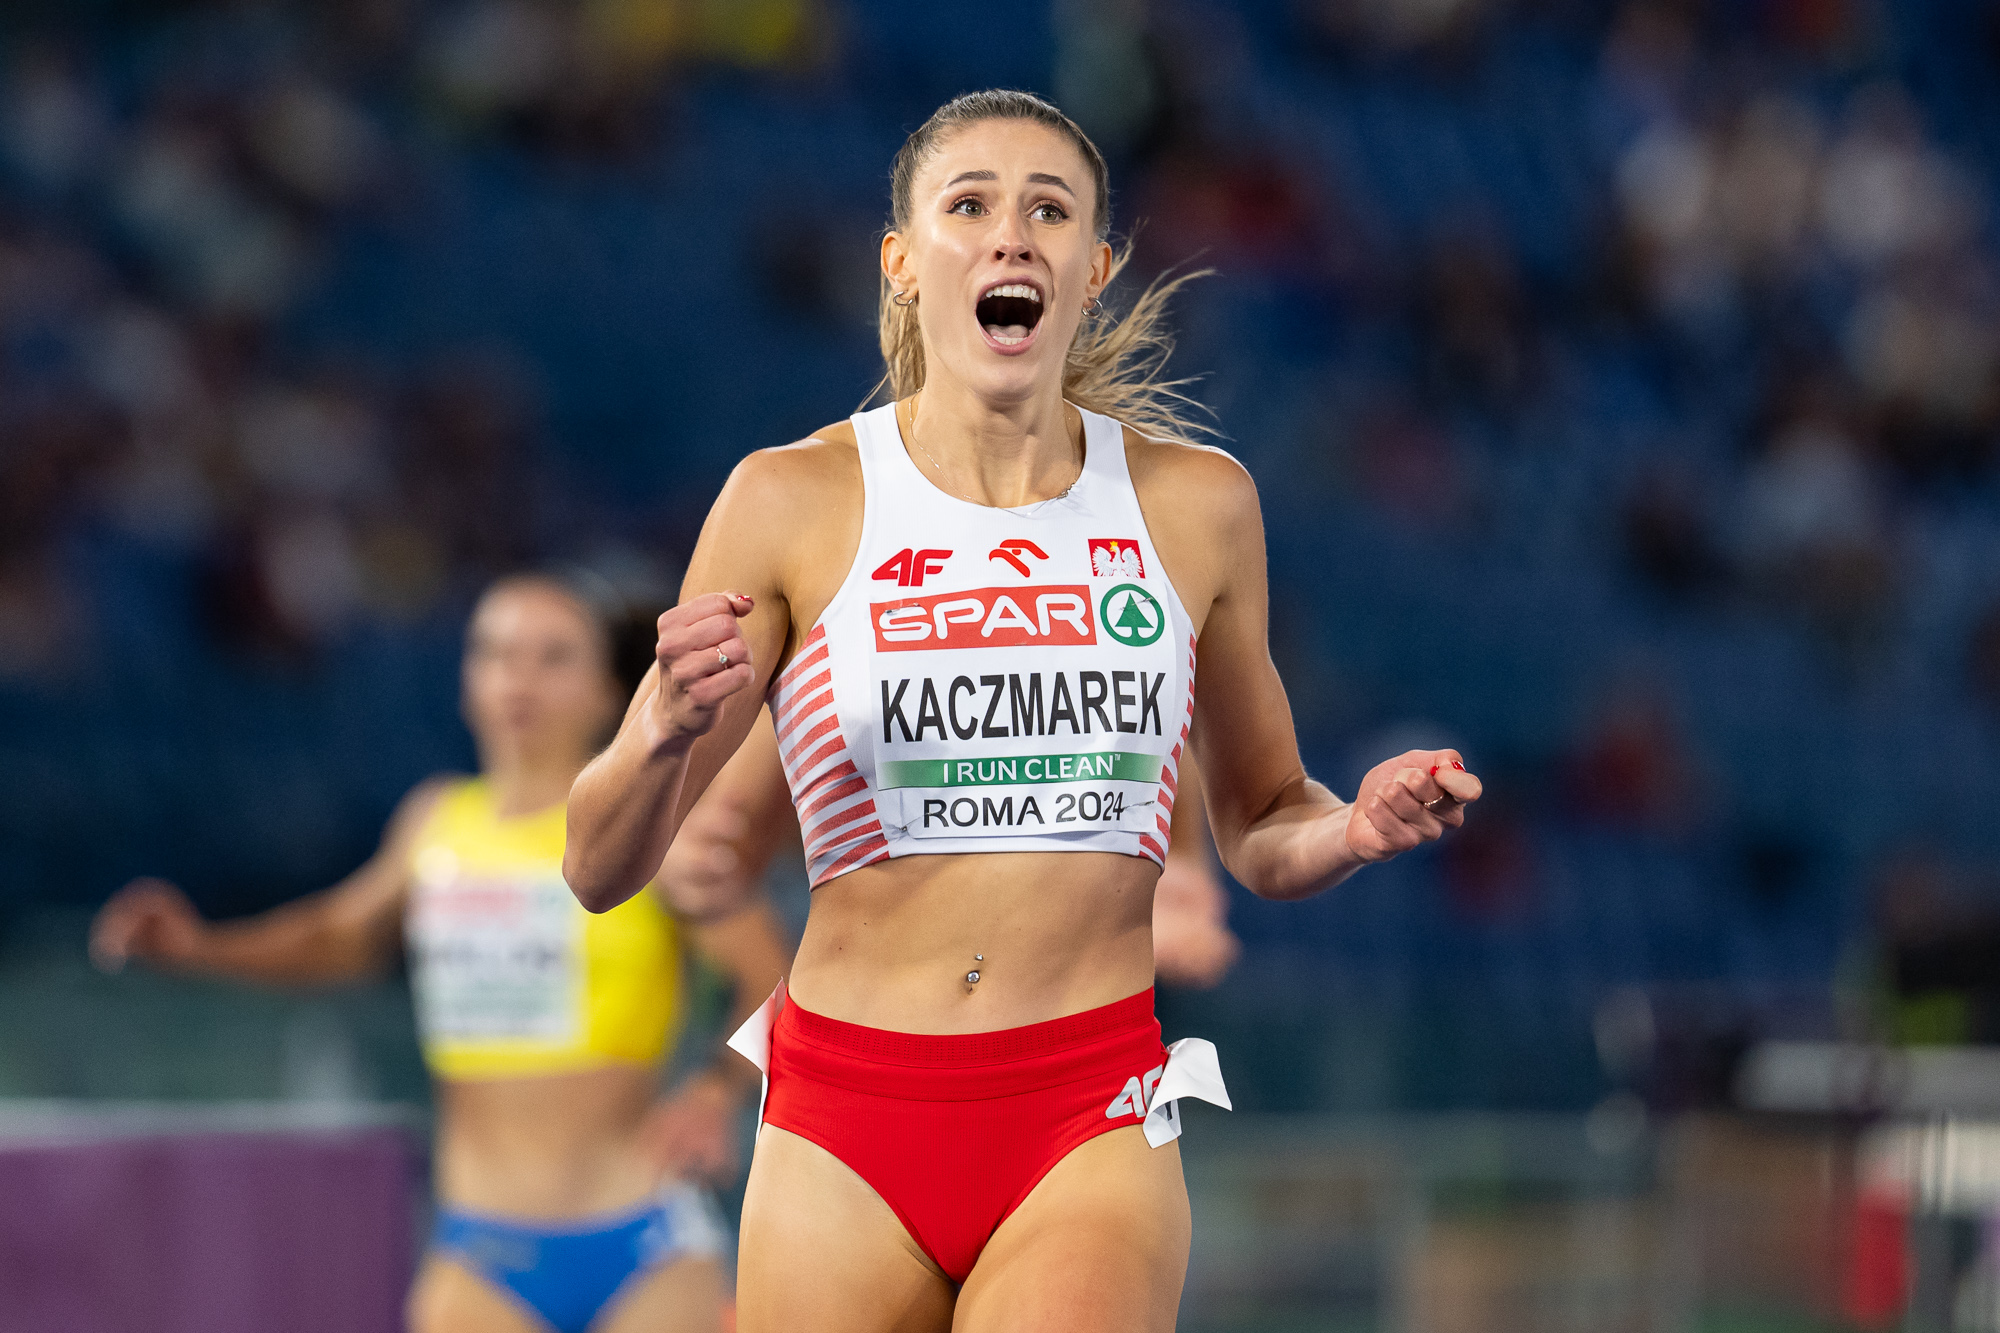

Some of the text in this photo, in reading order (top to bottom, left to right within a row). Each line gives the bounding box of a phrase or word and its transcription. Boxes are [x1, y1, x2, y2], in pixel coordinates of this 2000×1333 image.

[871, 548, 953, 587] 4F
[878, 593, 1090, 642] SPAR
[881, 670, 1166, 744] KACZMAREK
[943, 763, 949, 784] I
[957, 763, 1017, 783] RUN
[923, 791, 1124, 828] ROMA 2024
